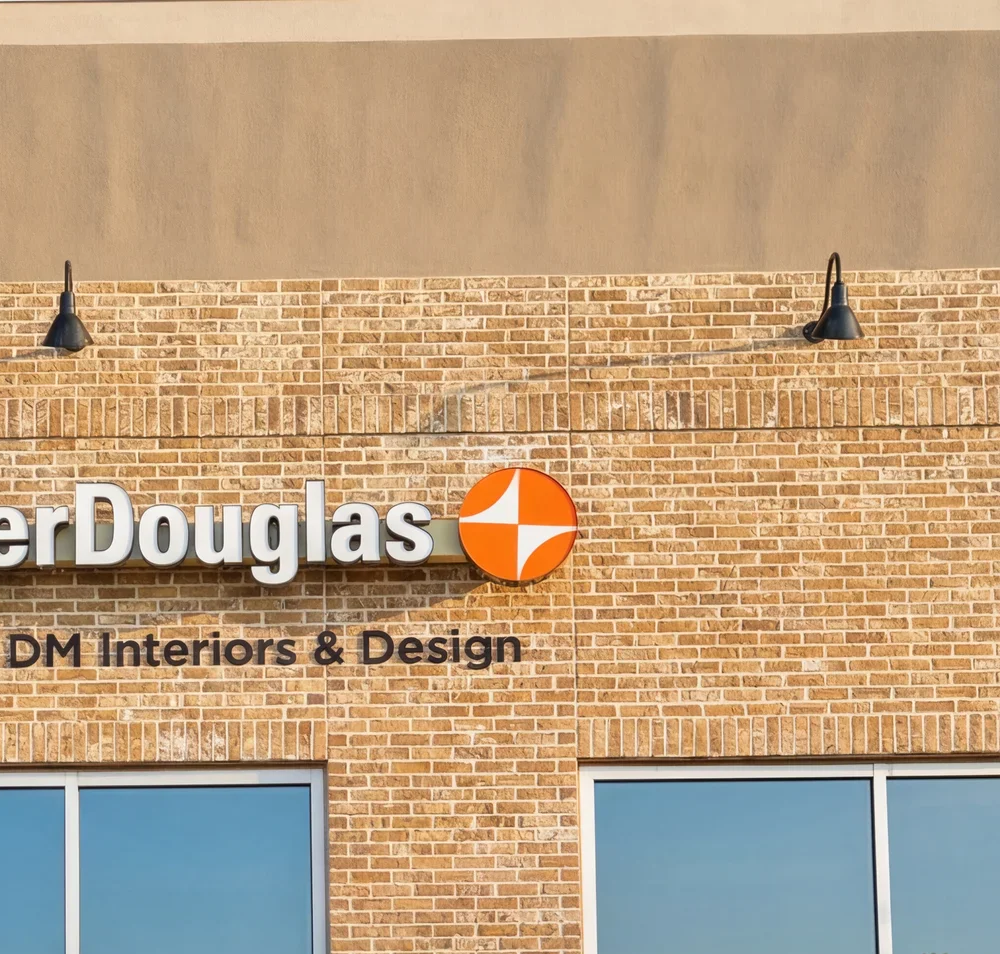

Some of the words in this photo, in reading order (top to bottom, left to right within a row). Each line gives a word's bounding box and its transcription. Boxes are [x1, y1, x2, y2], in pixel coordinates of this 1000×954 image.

[9, 633, 81, 668] DM
[102, 631, 297, 667] Interiors
[314, 630, 345, 666] &
[362, 629, 522, 670] Design
